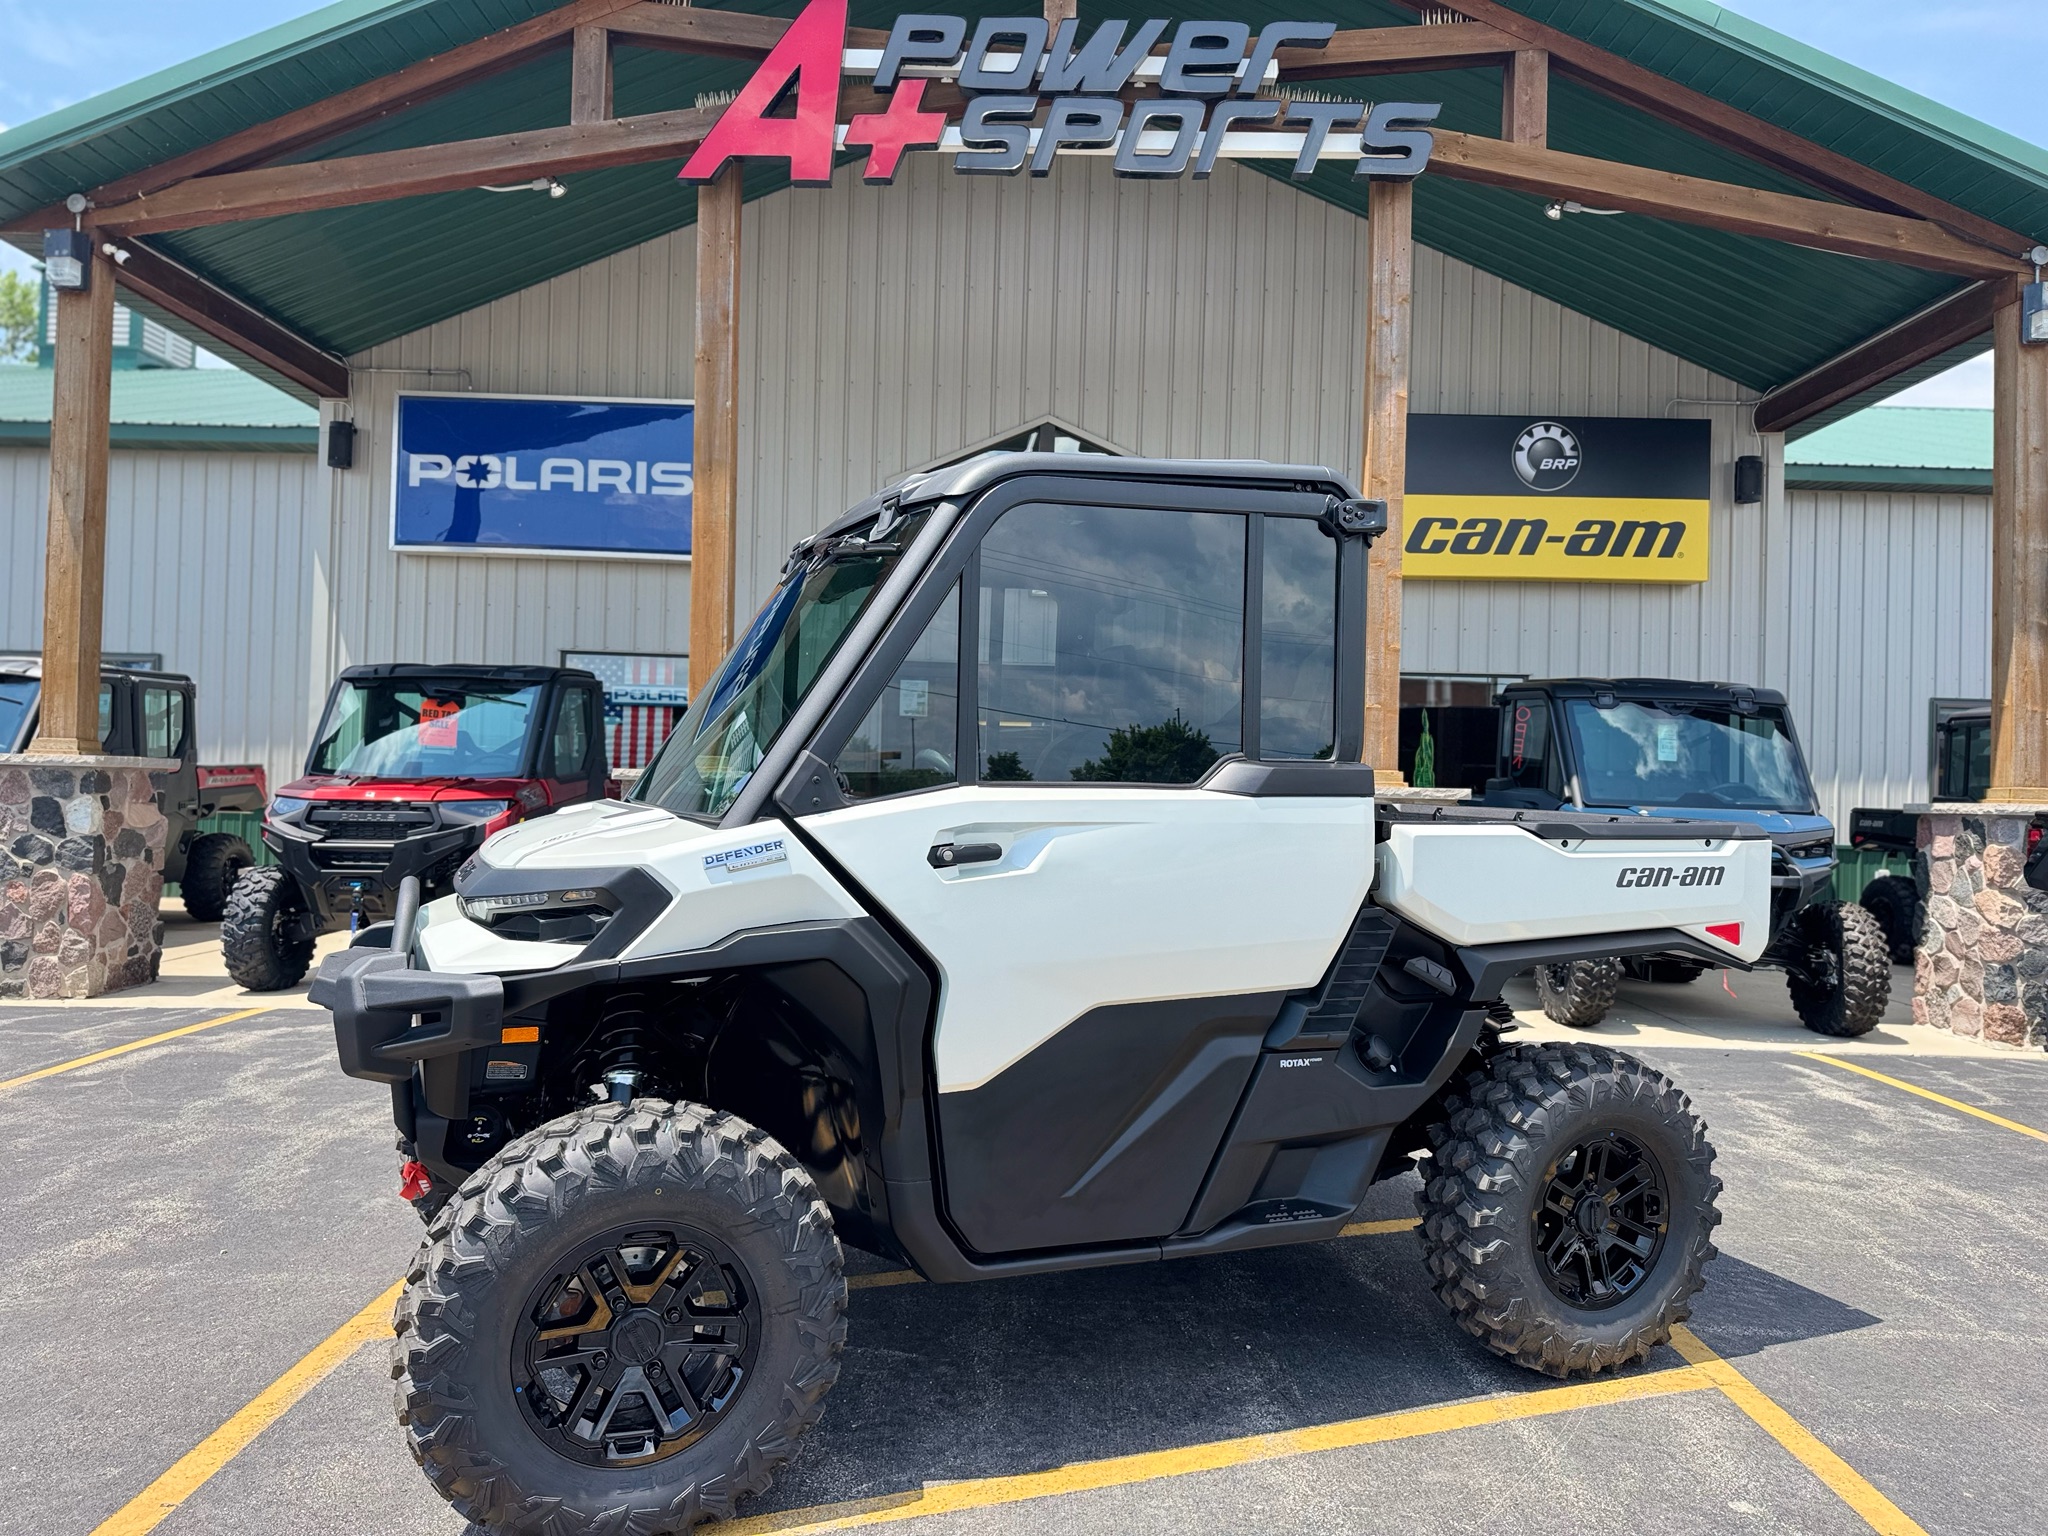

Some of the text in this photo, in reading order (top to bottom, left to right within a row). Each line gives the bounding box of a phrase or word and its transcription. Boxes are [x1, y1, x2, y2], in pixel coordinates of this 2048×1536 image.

[1539, 458, 1578, 470] BRP
[408, 453, 694, 496] POLARIS
[422, 709, 439, 718] RED
[704, 840, 784, 865] DEFENDER
[1616, 866, 1726, 888] can-am
[1280, 1058, 1310, 1068] ROTAX
